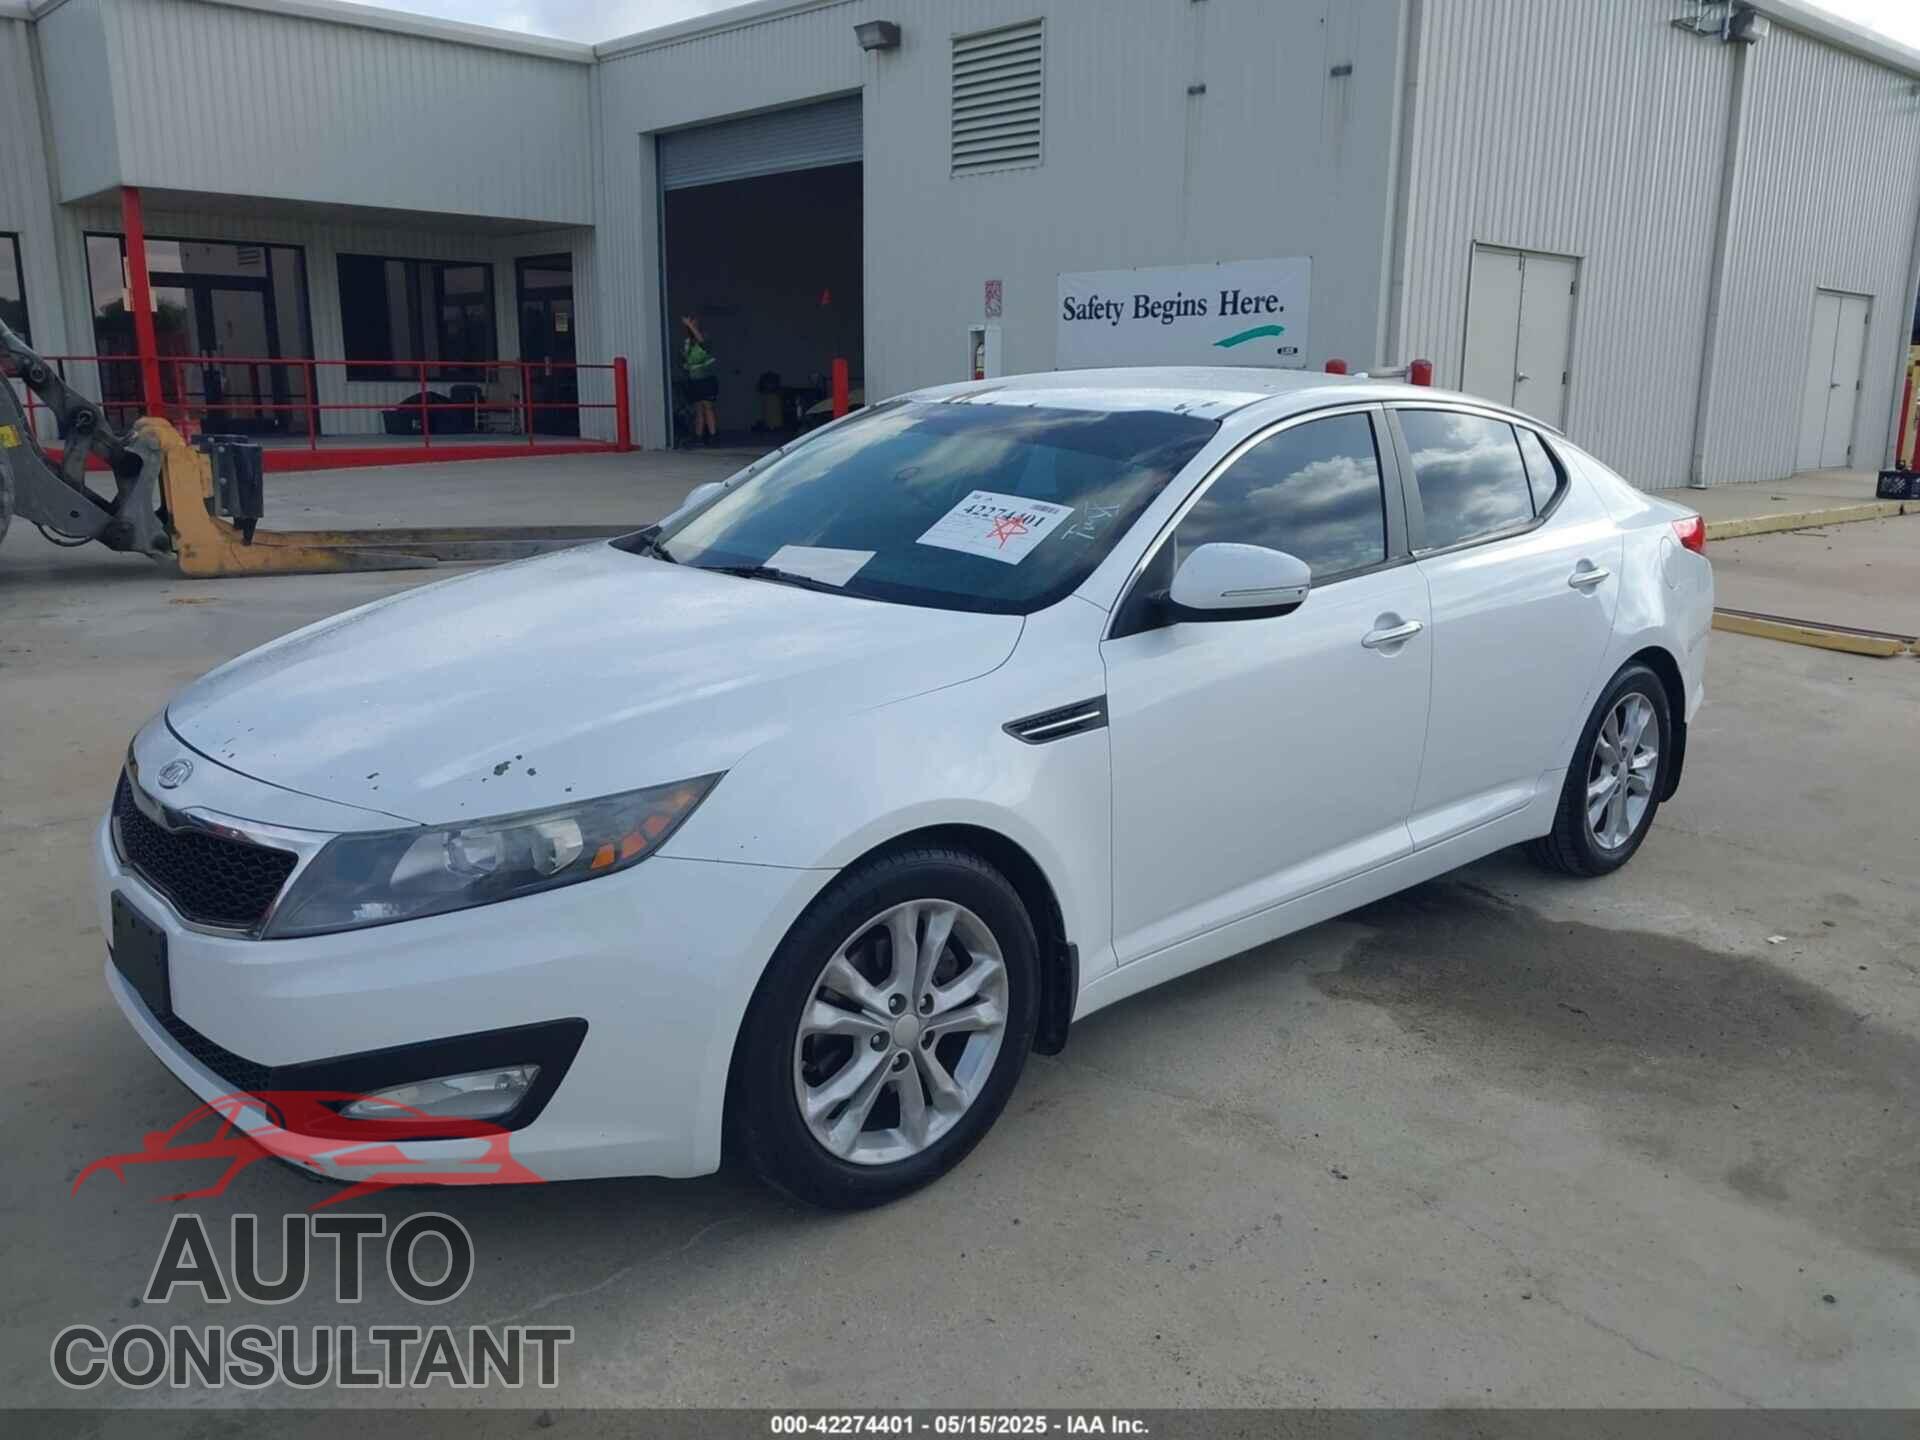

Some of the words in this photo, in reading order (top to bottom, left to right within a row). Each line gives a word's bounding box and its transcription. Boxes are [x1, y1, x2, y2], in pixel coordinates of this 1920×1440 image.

[1063, 296, 1124, 326] Safety
[1132, 291, 1207, 325] Begins
[1218, 289, 1285, 316] Here.
